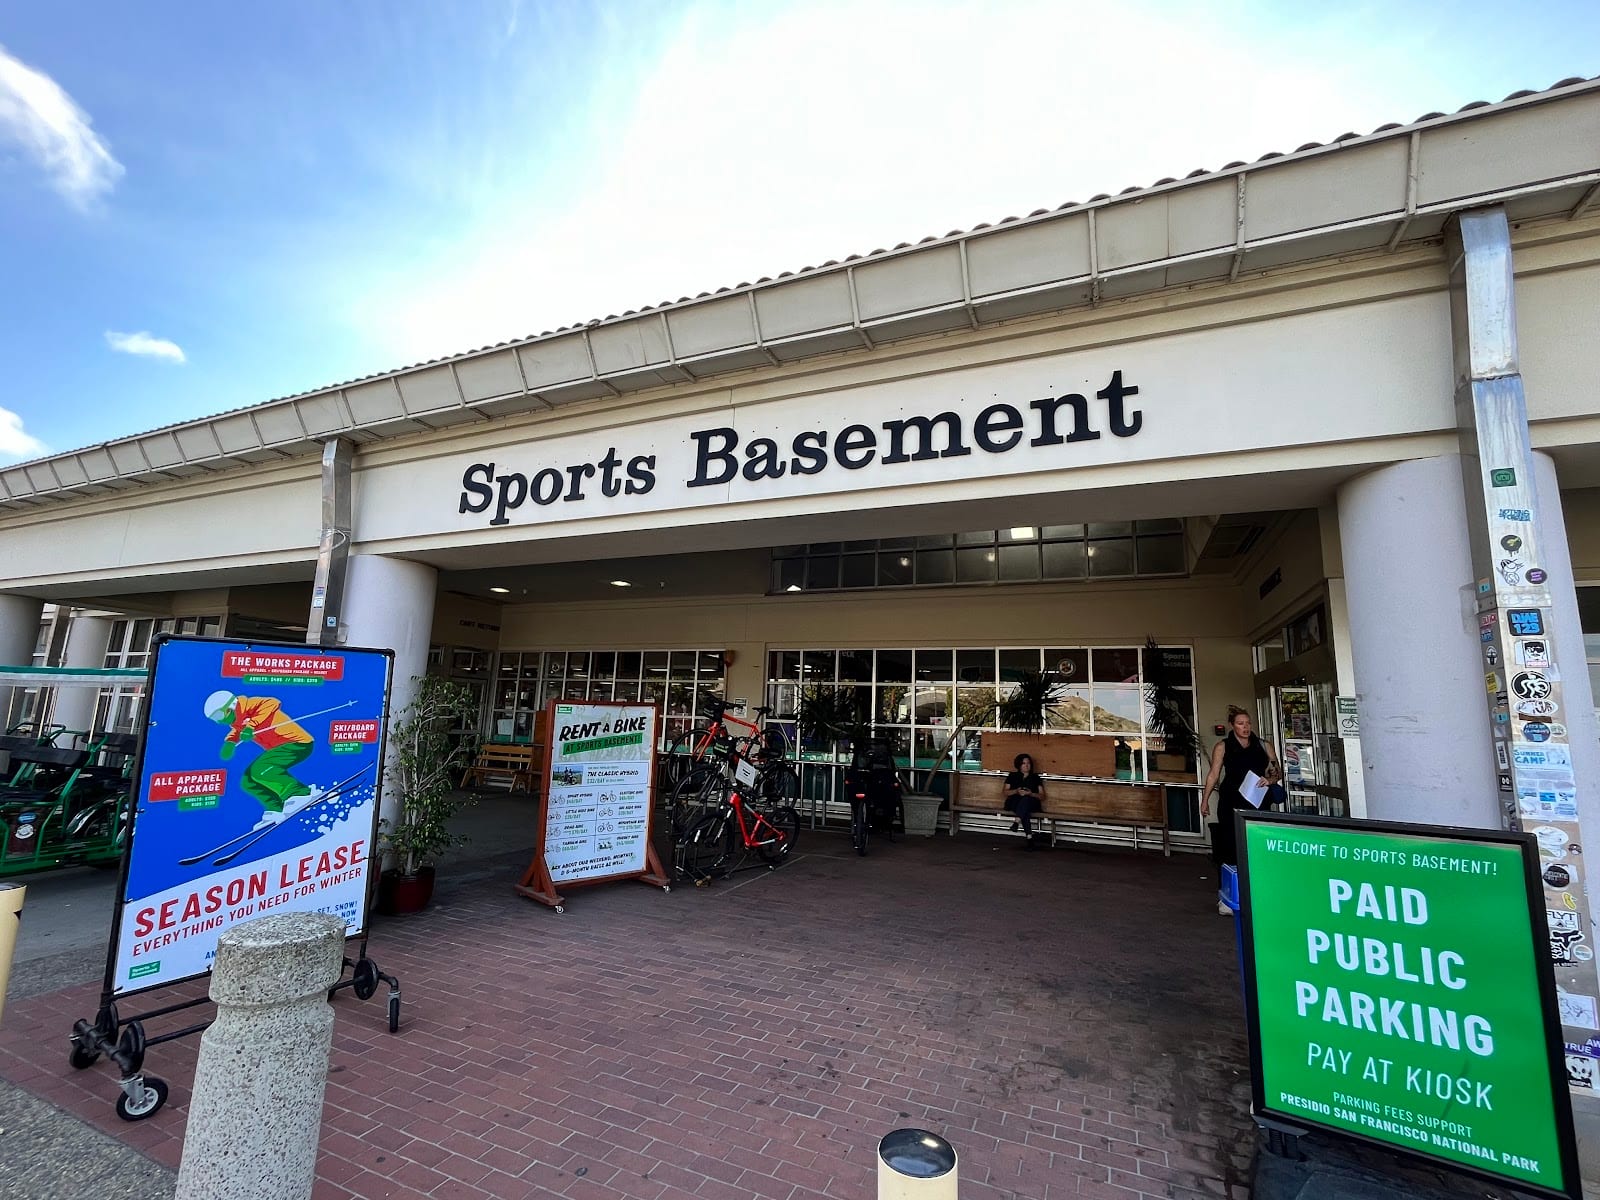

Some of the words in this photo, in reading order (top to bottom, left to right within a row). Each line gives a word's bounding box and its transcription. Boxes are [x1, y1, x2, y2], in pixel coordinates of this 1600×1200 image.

[459, 448, 656, 525] Sports
[687, 370, 1142, 488] Basement
[231, 656, 251, 666] THE
[255, 657, 291, 668] WORKS
[294, 660, 337, 670] PACKAGE
[334, 724, 375, 732] SKI/BOARD
[334, 732, 367, 740] PACKAGE
[559, 722, 601, 741] RENT
[603, 723, 610, 733] A
[613, 716, 647, 734] BIKE
[566, 743, 574, 752] AT
[577, 740, 602, 751] SPORTS
[1515, 756, 1546, 765] CAMP
[154, 777, 173, 787] ALL
[178, 774, 221, 785] APPAREL
[176, 783, 220, 794] PACKAGE
[561, 860, 578, 869] ABOUT
[1266, 838, 1327, 857] WELCOME
[1332, 845, 1348, 859] TO
[1353, 847, 1406, 866] SPORTS
[1412, 854, 1497, 876] BASEMENT!
[134, 870, 268, 938] SEASON
[280, 840, 365, 889] LEASE
[133, 915, 223, 957] EVERYTHING
[229, 904, 253, 922] YOU
[258, 892, 289, 911] NEED
[295, 883, 315, 899] FOR
[320, 867, 361, 890] WINTER
[335, 900, 358, 912] SNOW!
[1328, 878, 1429, 926] PAID
[1306, 928, 1467, 990] PUBLIC
[1295, 981, 1494, 1057] PARKING
[1565, 1042, 1592, 1055] TRUE
[1307, 1042, 1352, 1075] PAY
[1362, 1056, 1394, 1085] AT
[1406, 1068, 1493, 1111] KIOSK
[1333, 1091, 1381, 1115] PARKING
[1384, 1105, 1414, 1123] FEES
[1417, 1114, 1473, 1138] SUPPORT
[1280, 1092, 1331, 1116] PRESIDIO
[1334, 1106, 1358, 1124] SAN
[1361, 1114, 1429, 1143] FRANCISCO
[1431, 1133, 1499, 1162] NATIONAL
[1502, 1152, 1541, 1174] PARK
